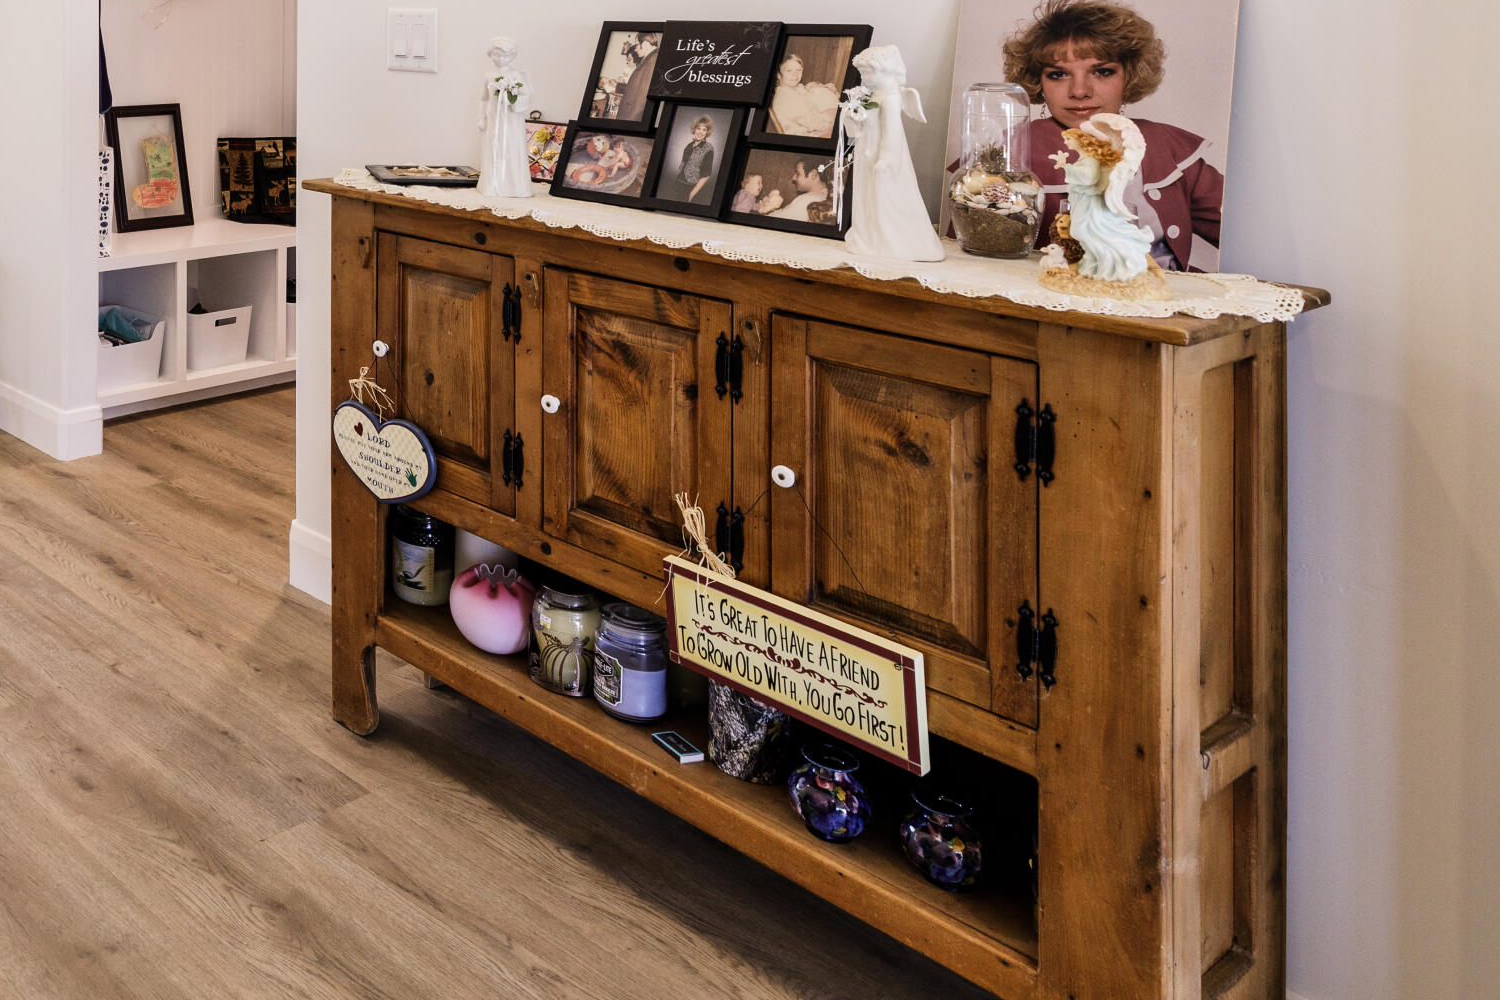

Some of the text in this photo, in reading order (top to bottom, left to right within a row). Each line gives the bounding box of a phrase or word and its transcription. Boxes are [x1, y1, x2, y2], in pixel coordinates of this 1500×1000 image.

[676, 39, 716, 52] Life's
[664, 44, 754, 83] greatest
[688, 69, 752, 87] blessings
[359, 451, 402, 475] SHOULDER
[367, 476, 394, 494] MOUTH
[720, 598, 758, 639] GREAT
[761, 615, 777, 647] TO
[779, 624, 814, 664] HAVE
[819, 641, 830, 671] A
[830, 645, 880, 691] FRIEND
[697, 632, 733, 673] GROW
[736, 651, 762, 685] OLD
[803, 679, 831, 716] YOU
[832, 692, 855, 726] GO
